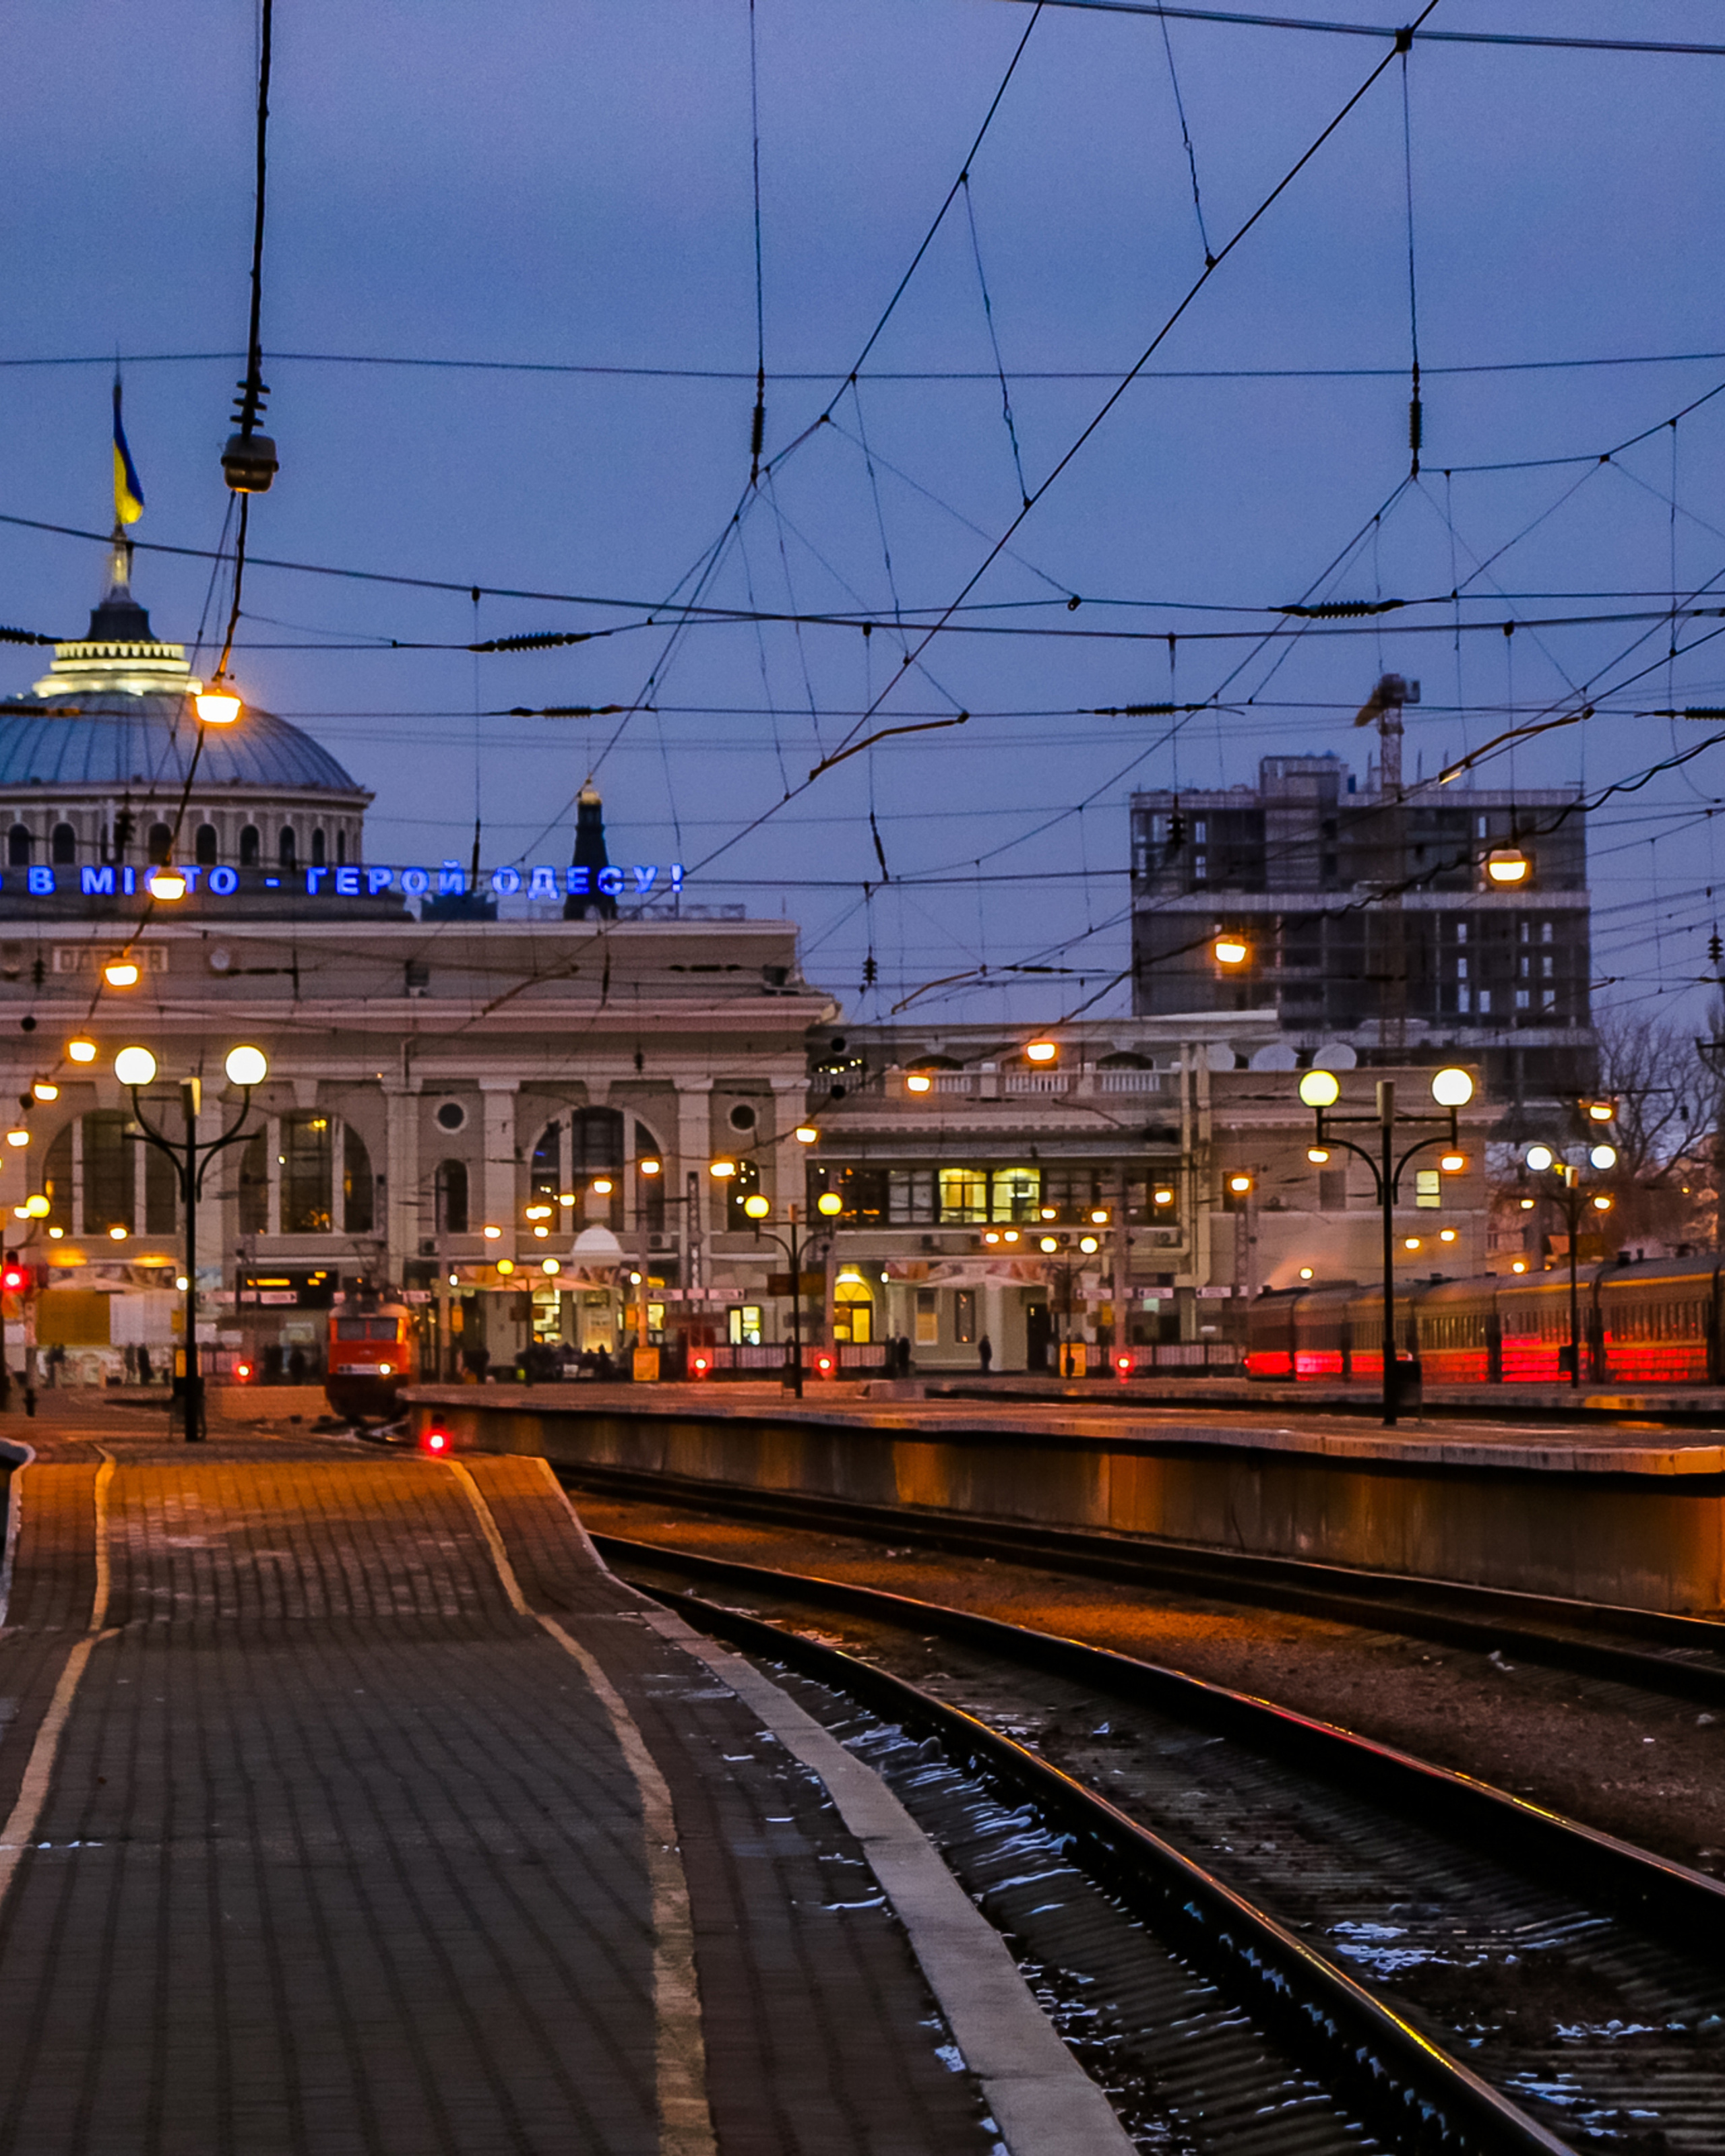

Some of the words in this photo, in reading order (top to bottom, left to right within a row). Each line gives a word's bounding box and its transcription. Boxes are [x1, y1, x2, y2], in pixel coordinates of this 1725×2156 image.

[28, 866, 56, 896] В
[306, 860, 466, 896] ГЕРОЙ
[491, 863, 685, 901] ОДЕСУ!
